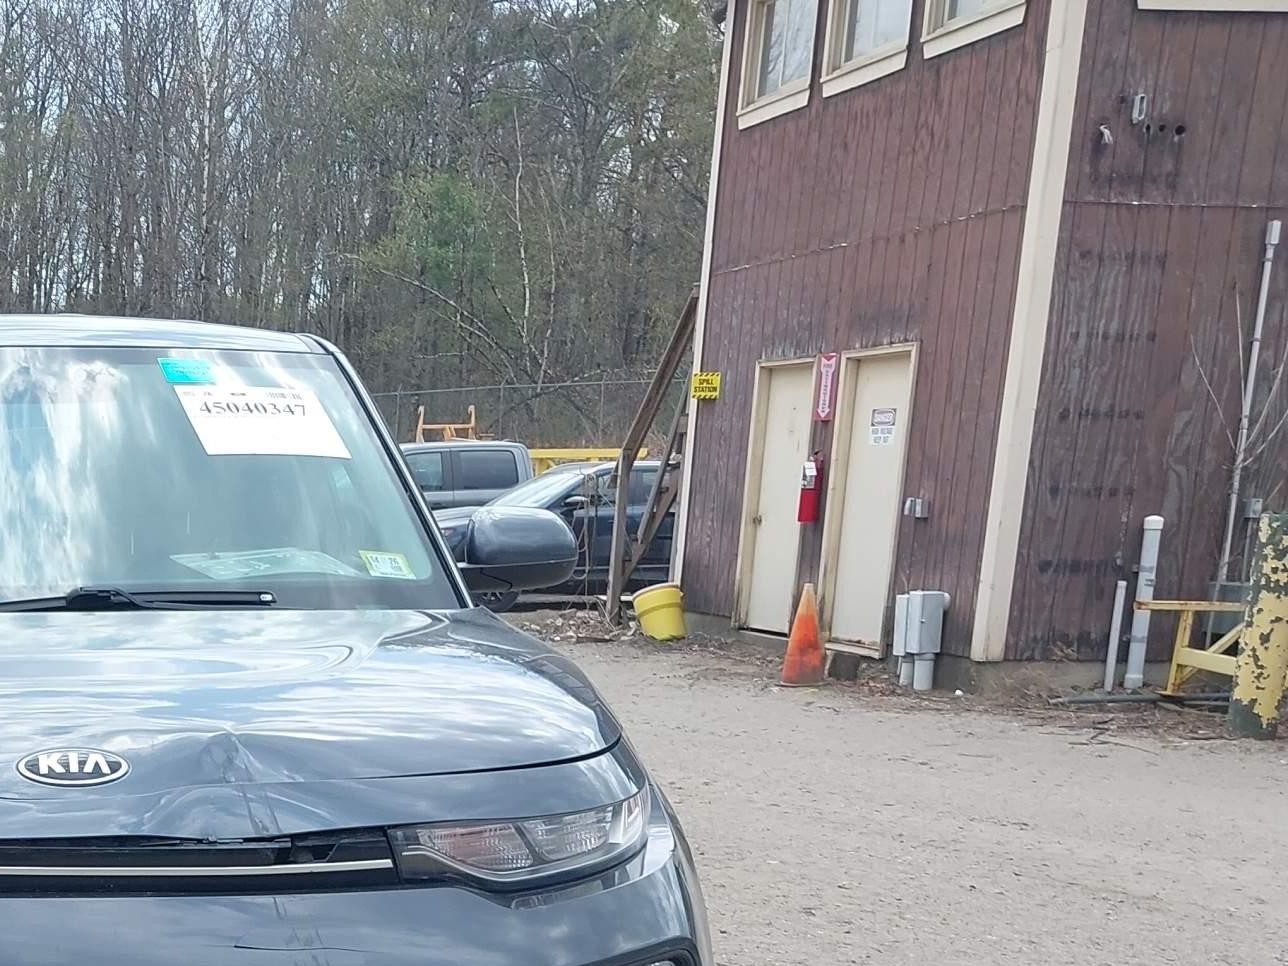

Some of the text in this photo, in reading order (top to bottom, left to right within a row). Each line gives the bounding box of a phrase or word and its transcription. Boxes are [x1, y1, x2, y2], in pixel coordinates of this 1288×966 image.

[698, 378, 714, 386] SPILL
[199, 401, 307, 416] 45040347
[38, 752, 111, 775] KIA
